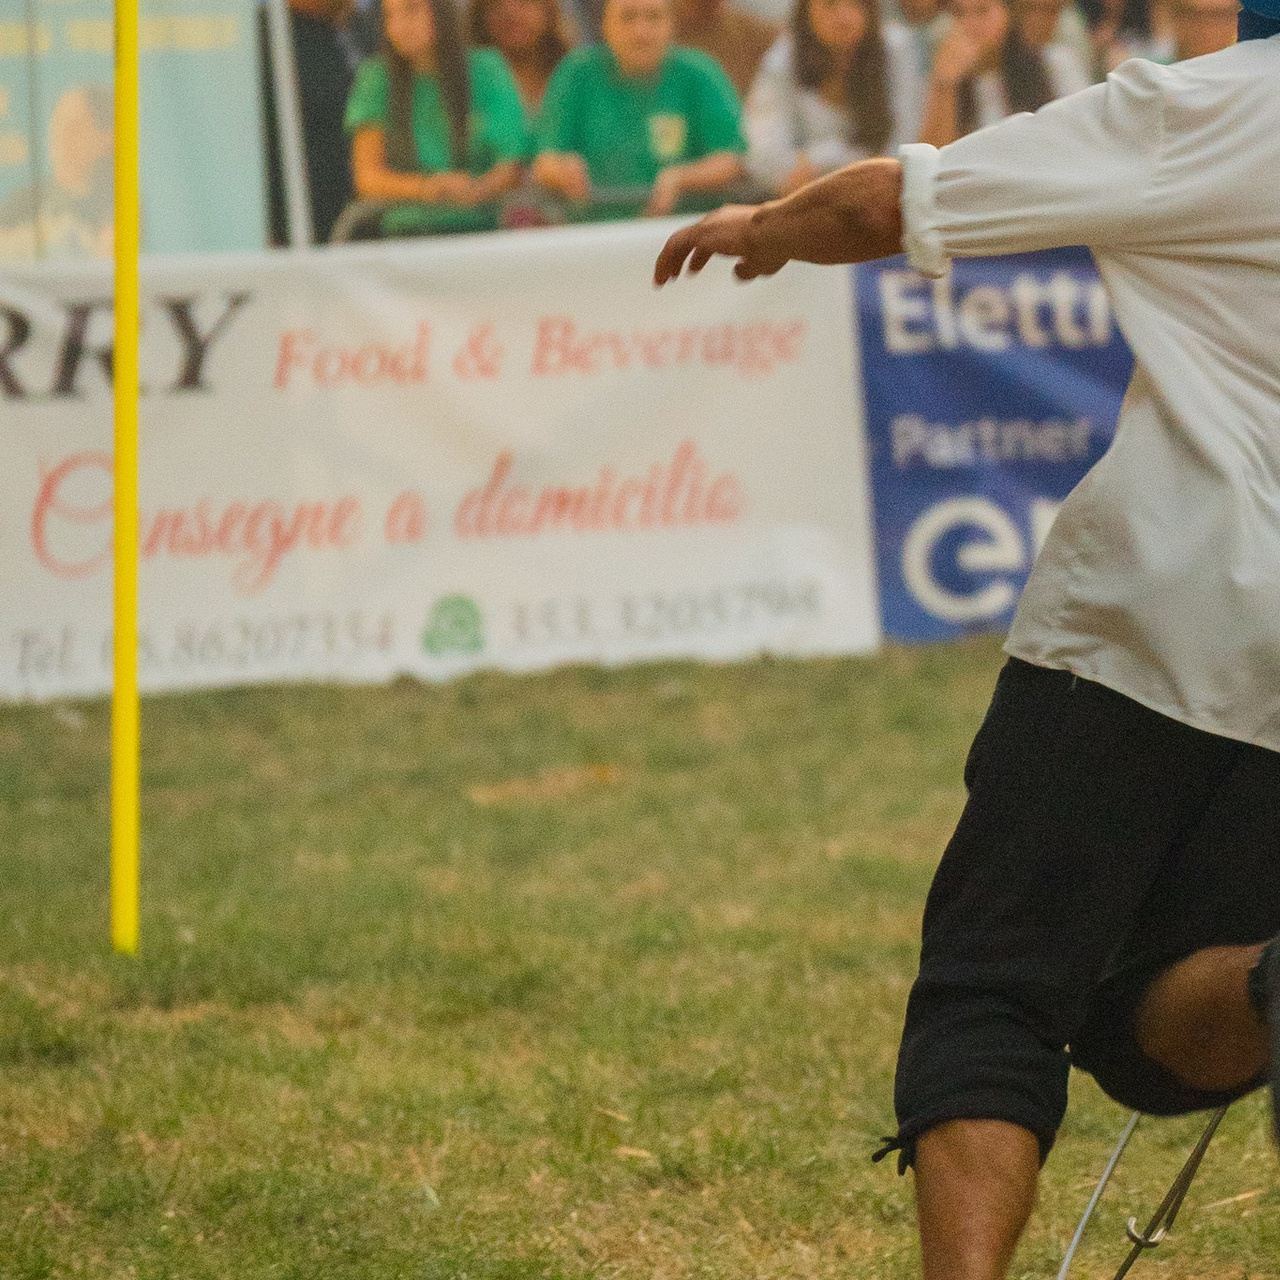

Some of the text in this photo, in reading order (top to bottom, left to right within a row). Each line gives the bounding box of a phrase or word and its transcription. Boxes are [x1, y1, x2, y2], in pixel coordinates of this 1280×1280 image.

[273, 322, 432, 389] Food
[452, 324, 505, 380] &
[531, 315, 807, 380] Beverage
[889, 415, 1093, 470] Partner
[30, 440, 745, 597] Cnsegne a domicilio
